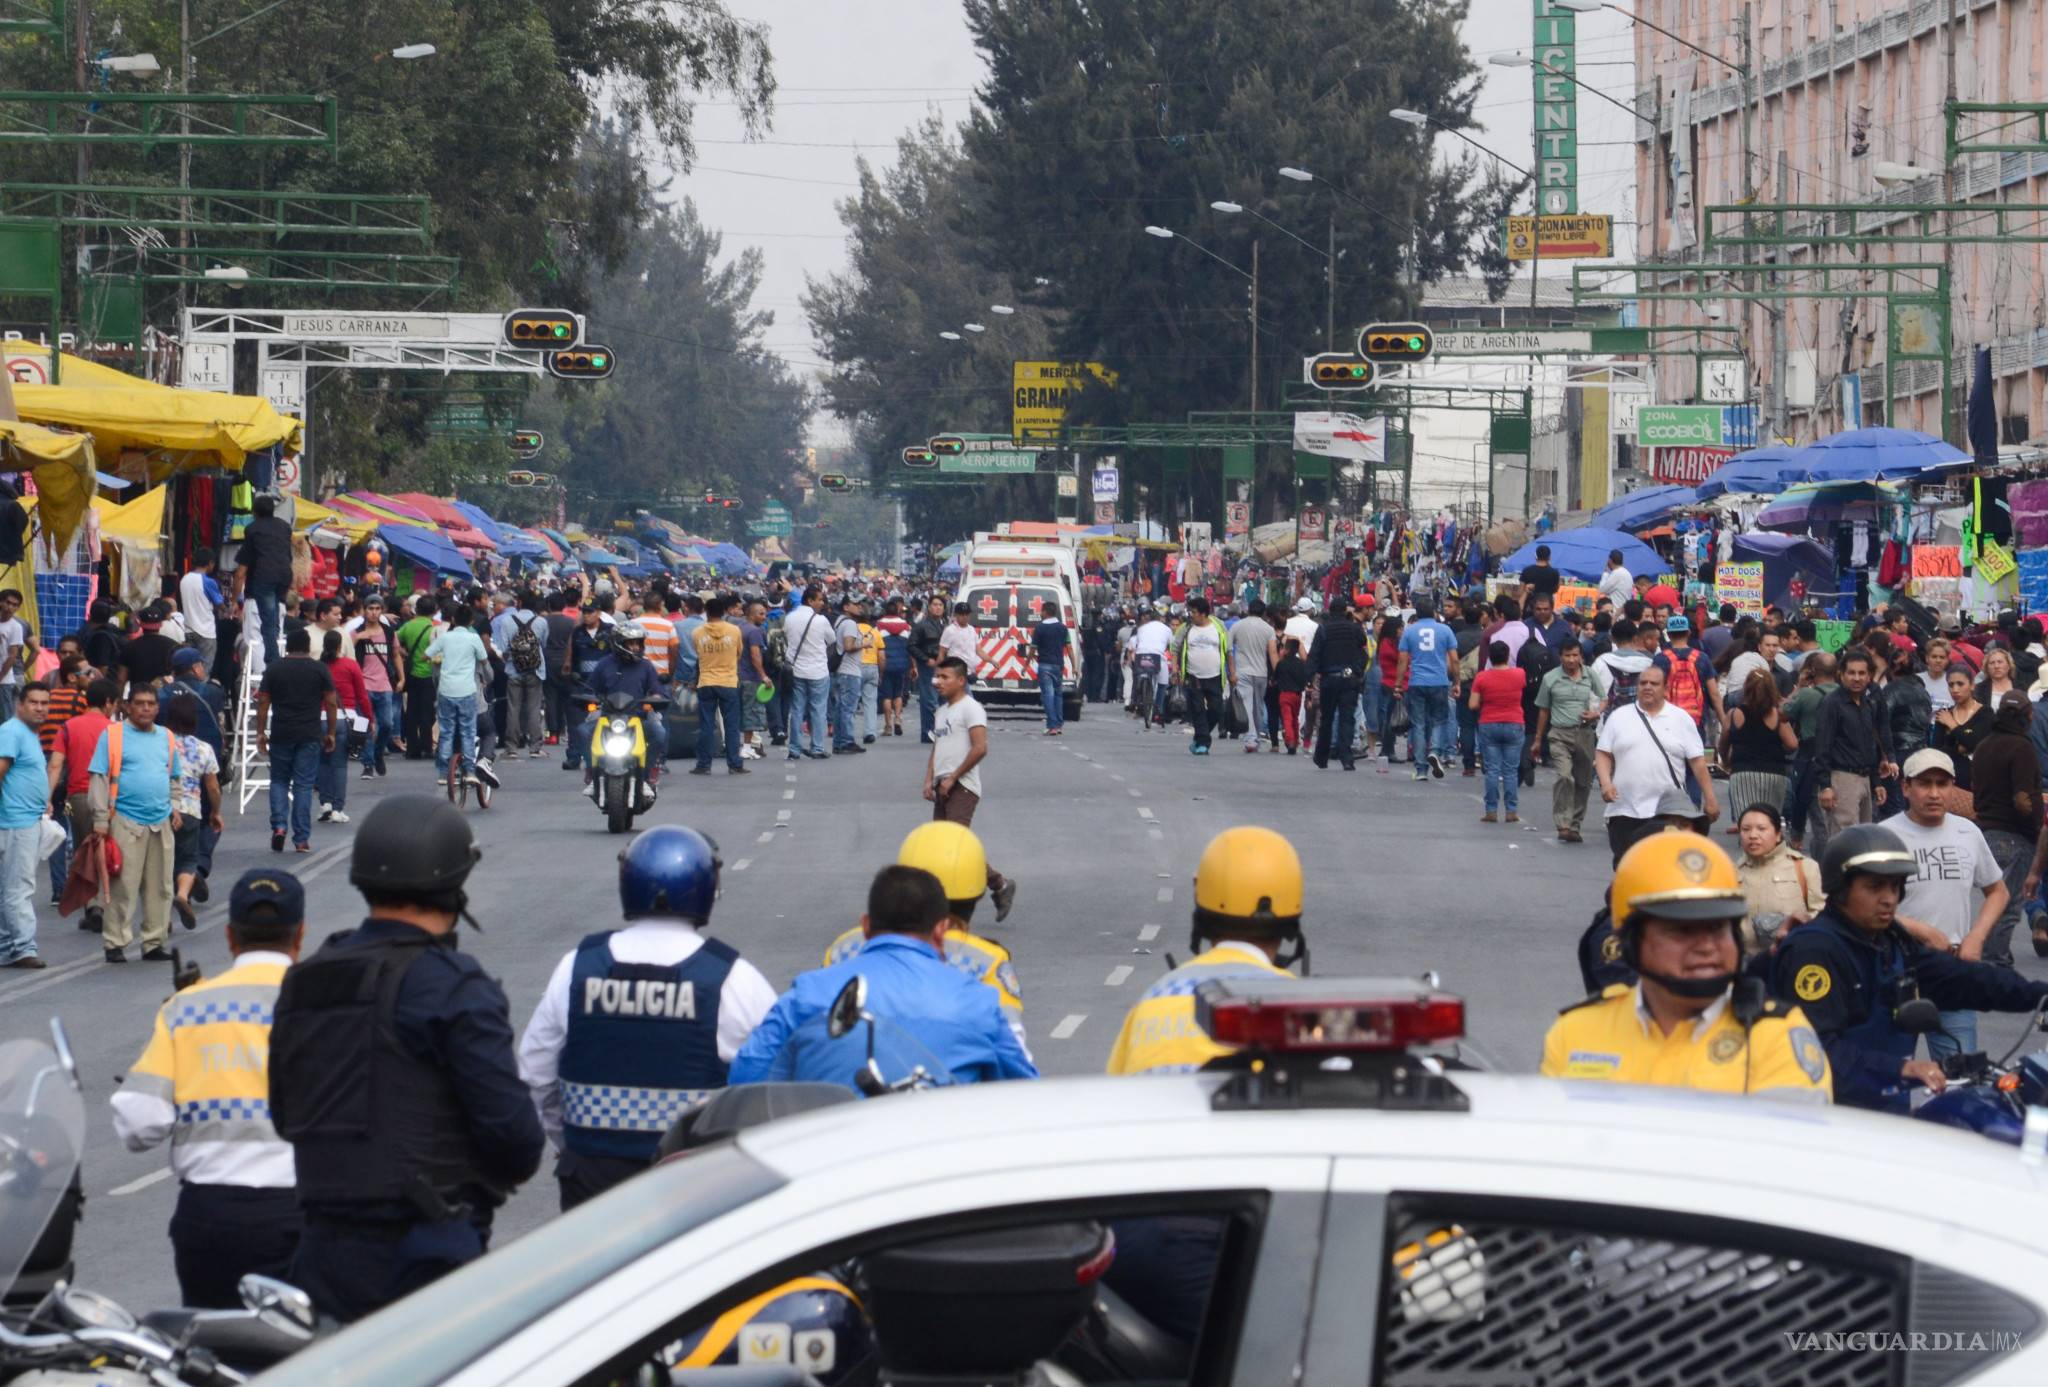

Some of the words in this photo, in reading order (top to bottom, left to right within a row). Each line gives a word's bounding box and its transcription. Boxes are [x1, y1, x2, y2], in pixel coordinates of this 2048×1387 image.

[1510, 218, 1604, 233] ESTACIONAMIENTO
[293, 319, 333, 332] JESUS
[339, 319, 408, 333] CARRANZA
[1463, 336, 1475, 348] DE
[1481, 335, 1540, 348] ARGENTINA
[194, 345, 218, 354] EJE
[204, 355, 209, 370] 1
[192, 372, 220, 383] NTE
[270, 372, 290, 380] EJE
[279, 382, 284, 393] 1
[1710, 389, 1736, 399] NTE
[270, 395, 293, 405] NTE
[1620, 418, 1636, 426] NT
[1645, 412, 1676, 421] ZONA
[961, 455, 1030, 467] AEROPUERTO
[1718, 567, 1734, 576] HOT
[1738, 567, 1761, 577] DOGS
[1418, 628, 1435, 651] 3
[584, 977, 696, 1019] POLICIA
